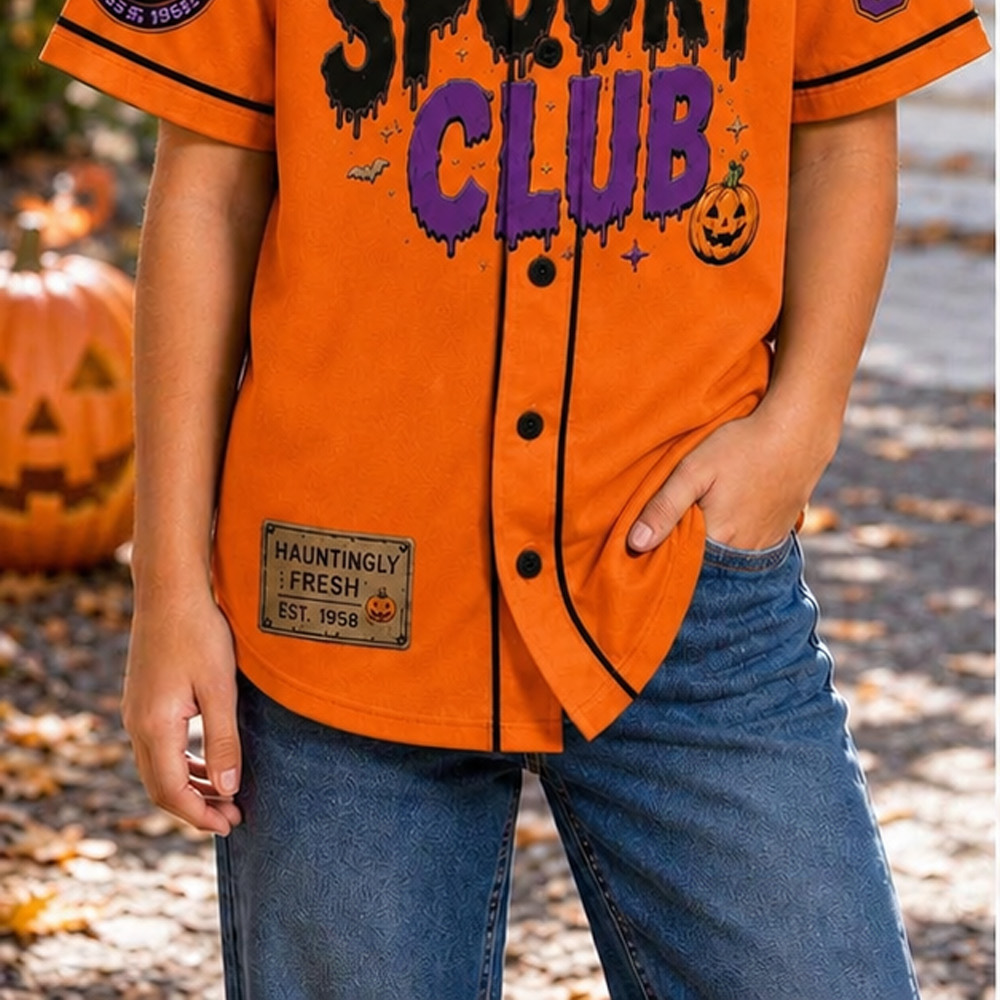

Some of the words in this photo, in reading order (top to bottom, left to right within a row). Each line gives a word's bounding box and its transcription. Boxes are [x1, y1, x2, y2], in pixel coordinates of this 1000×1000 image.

[407, 65, 713, 258] CLUB
[275, 540, 400, 574] HAUNTINGLY
[289, 570, 360, 598] FRESH
[279, 601, 311, 623] EST.
[320, 608, 359, 628] 1958
